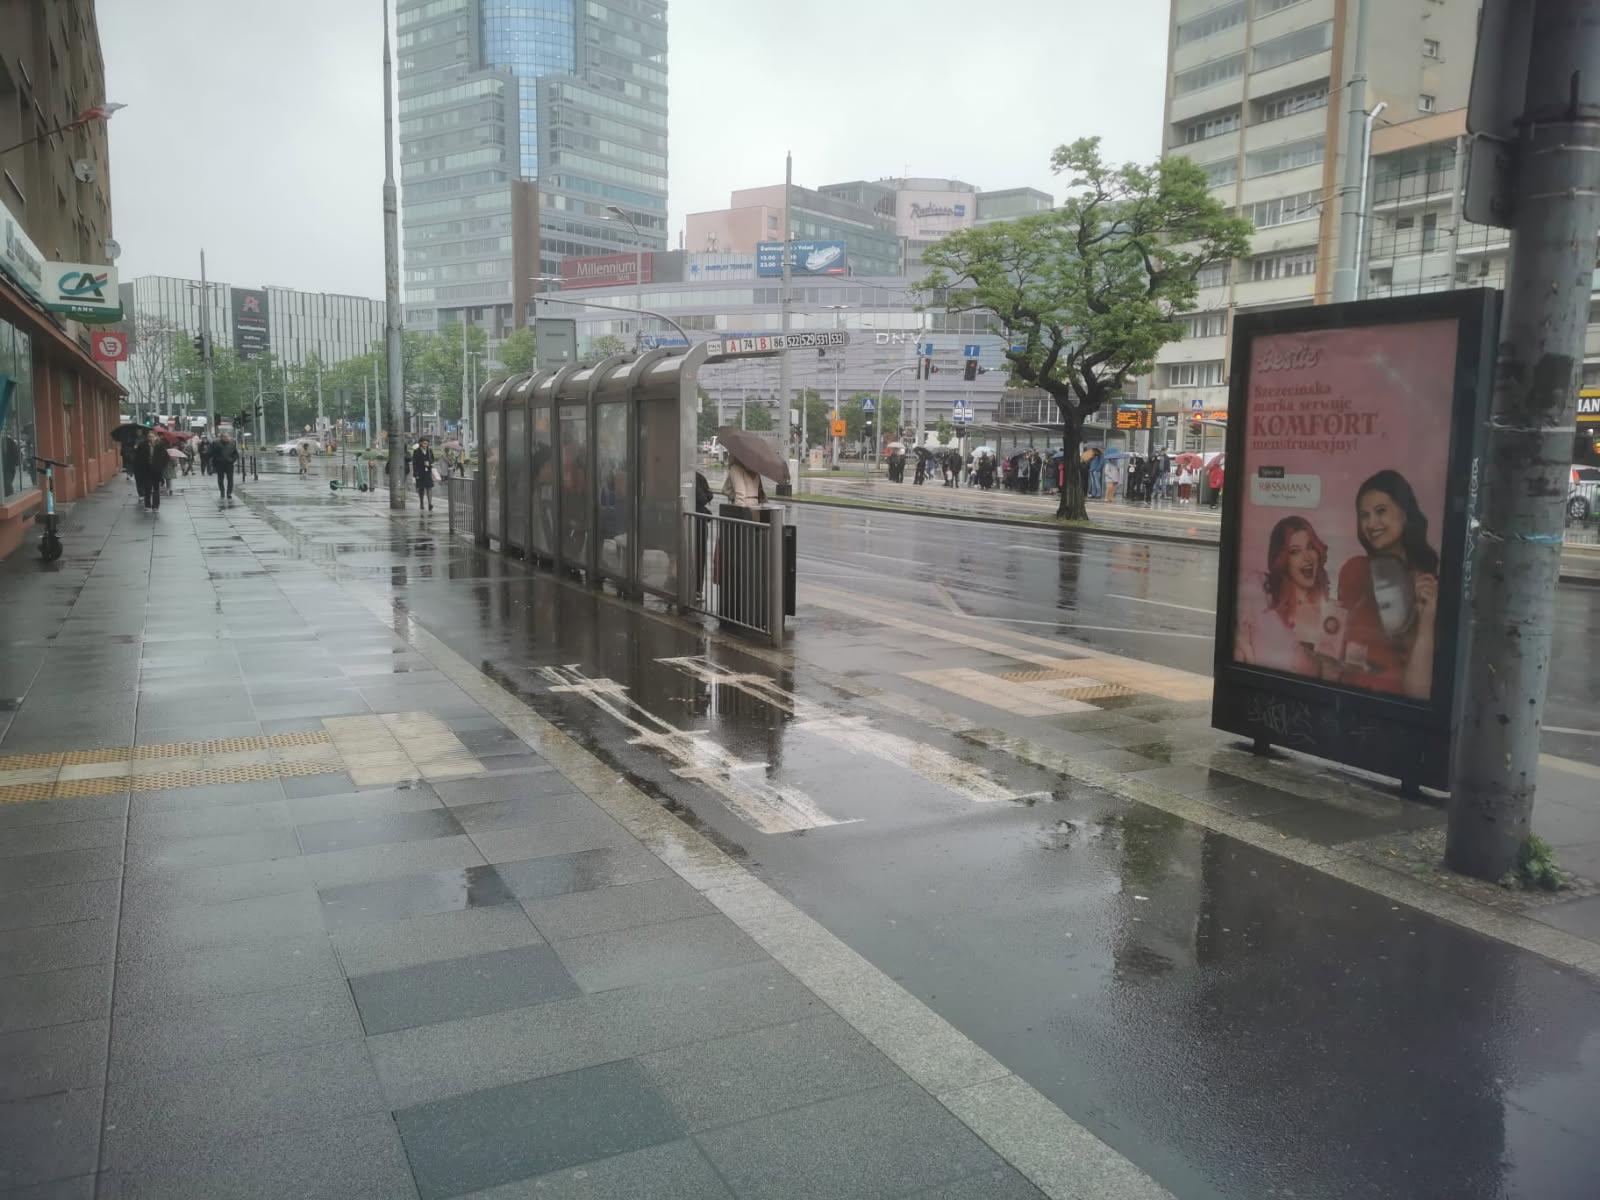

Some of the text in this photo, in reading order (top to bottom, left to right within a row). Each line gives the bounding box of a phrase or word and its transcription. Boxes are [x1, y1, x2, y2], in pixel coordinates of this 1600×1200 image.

[577, 261, 636, 276] Millennium
[730, 341, 737, 352] A
[760, 338, 767, 350] B
[787, 336, 800, 347] 522
[1253, 396, 1352, 413] marka serwuje
[1252, 411, 1379, 437] KOMFORT
